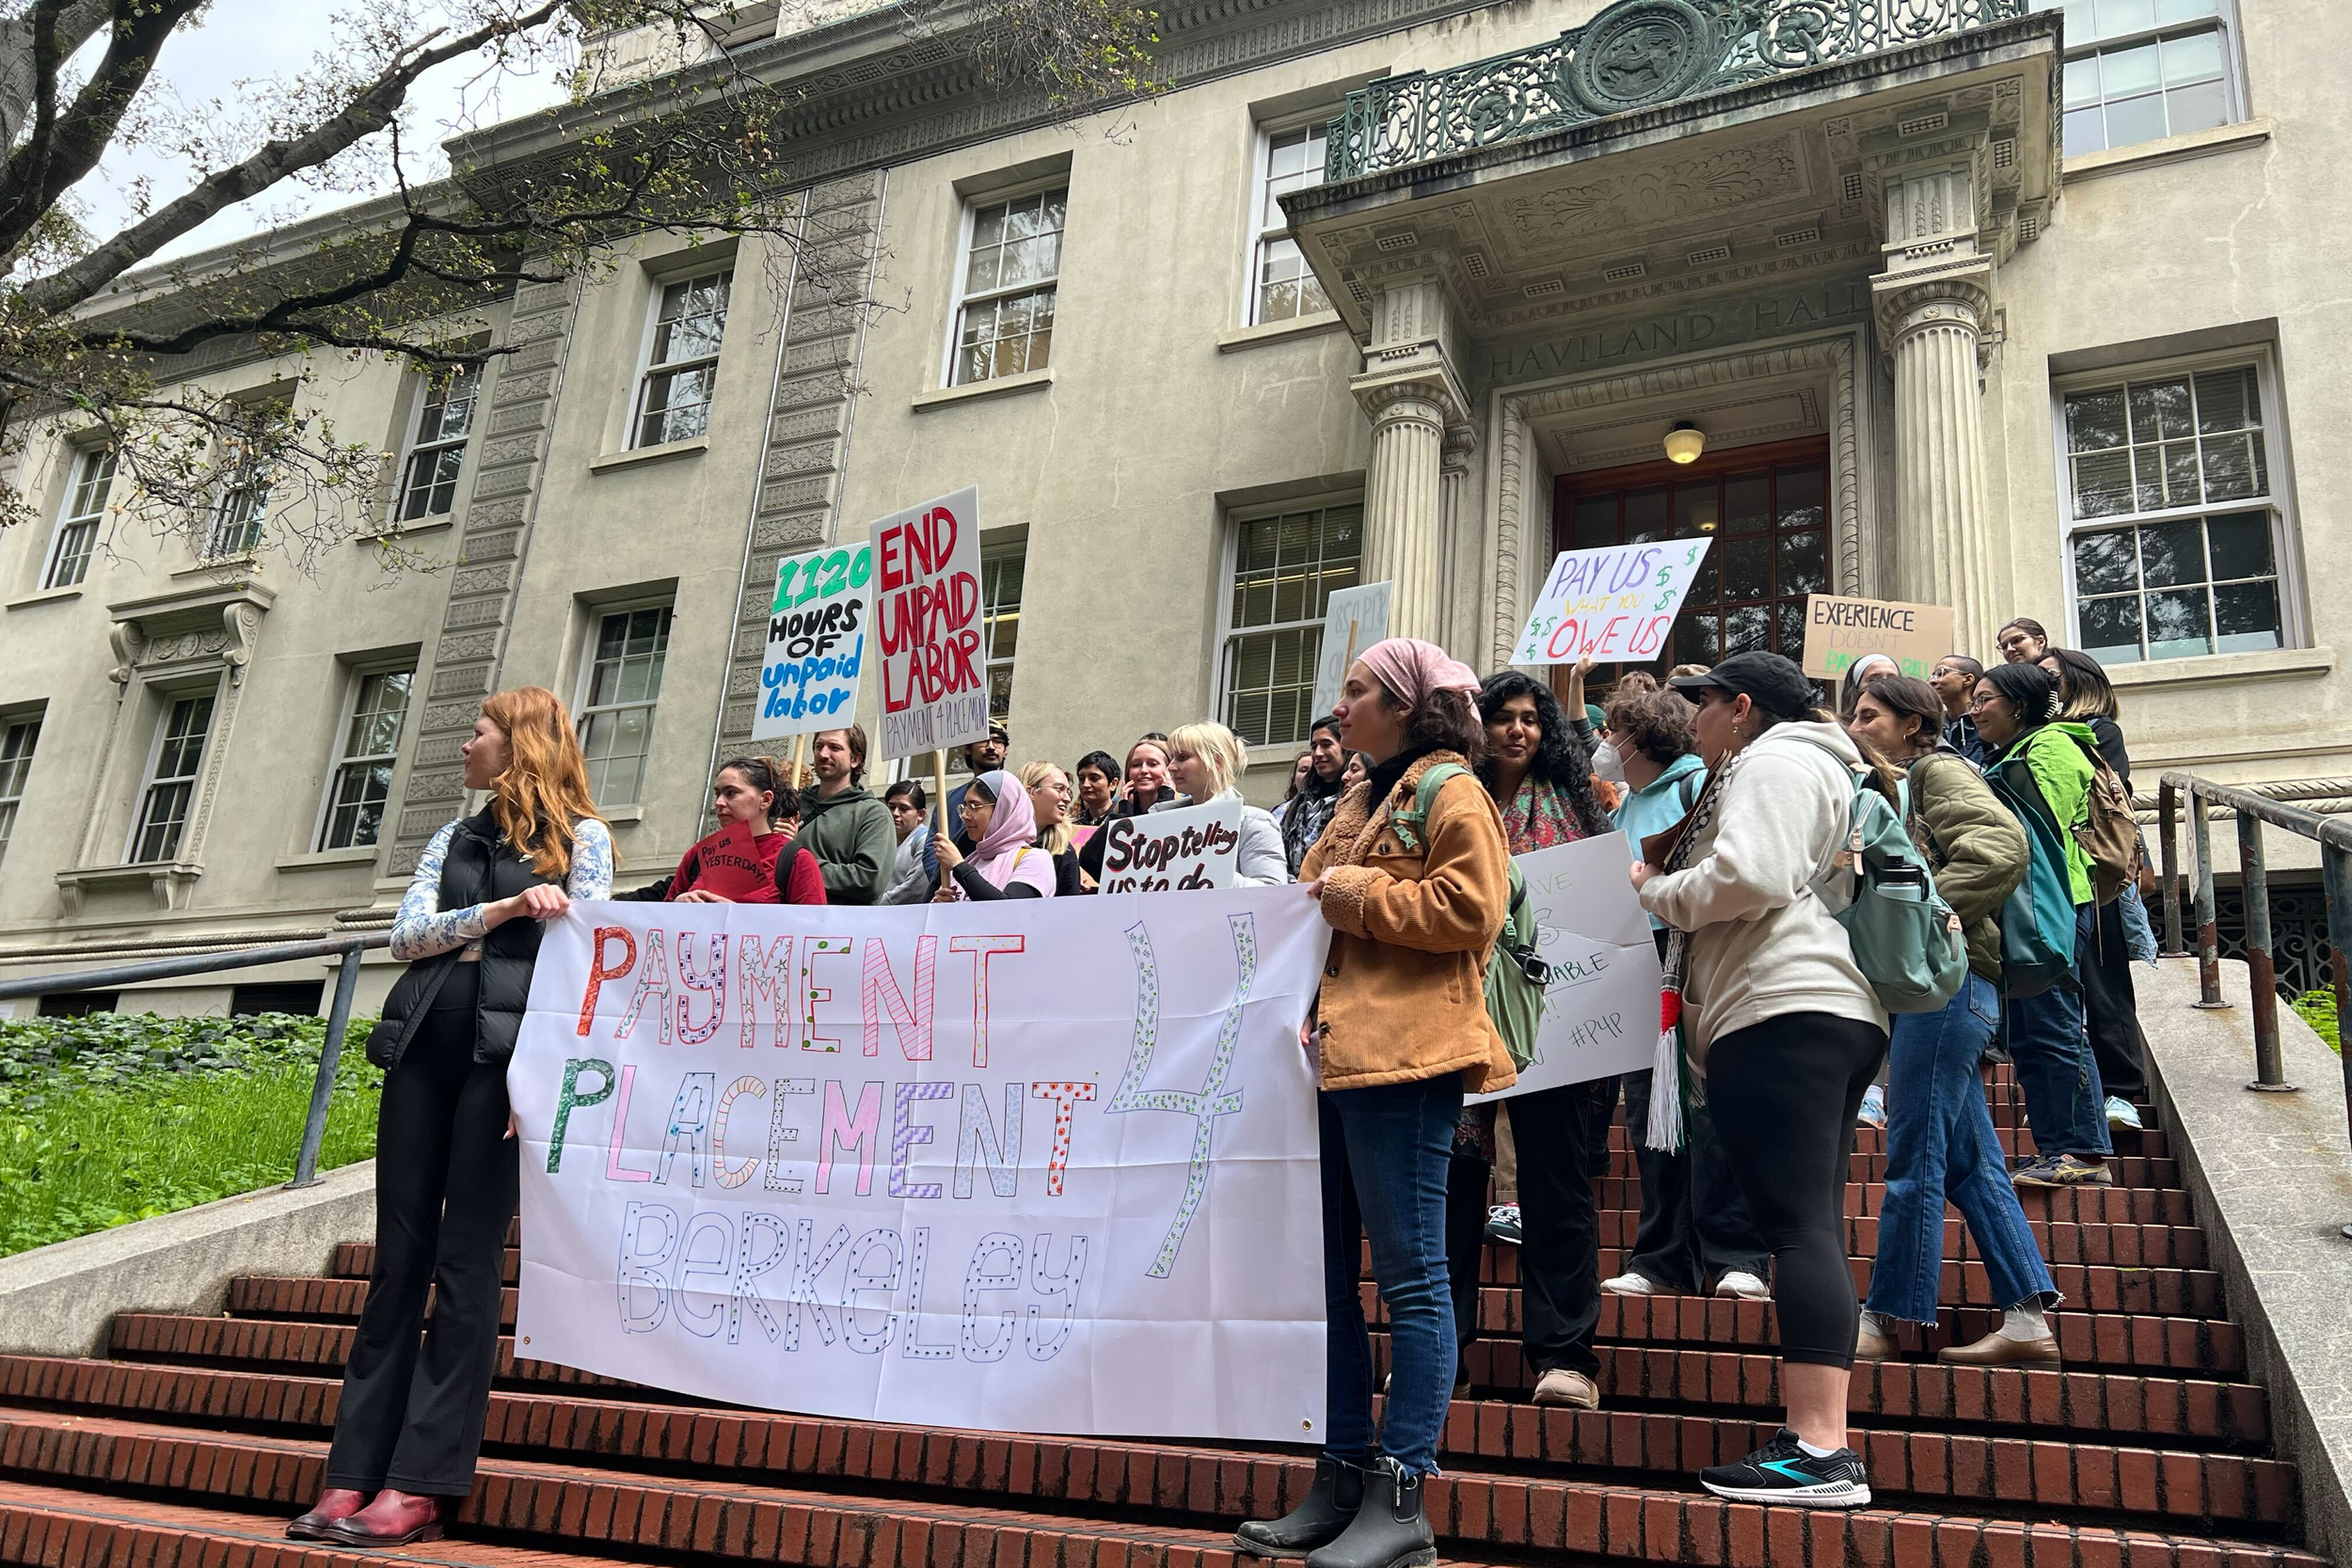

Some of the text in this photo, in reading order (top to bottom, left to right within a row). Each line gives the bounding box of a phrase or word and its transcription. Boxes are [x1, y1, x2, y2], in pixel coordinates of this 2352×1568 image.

[1489, 282, 1873, 379] HAVILAND HALL
[880, 506, 958, 593] END
[1550, 547, 1662, 599] PAY US
[771, 546, 871, 615] 1120
[1565, 594, 1645, 616] WHAT YOU
[768, 598, 864, 642] HOURS
[878, 571, 978, 657] UNPAID
[1547, 615, 1671, 658] OWE US
[1814, 600, 1915, 632] EXPERIENCE
[1830, 628, 1902, 651] DOESN'T
[762, 633, 864, 689] unpaid
[787, 634, 842, 659] OF
[882, 629, 982, 715] LABOR
[763, 687, 851, 721] labor
[885, 705, 934, 755] PAYMENT
[937, 704, 945, 740] 4
[702, 836, 732, 858] Pay us
[705, 854, 767, 884] YESTERDAY!
[1105, 818, 1180, 873] Stop
[1180, 820, 1239, 860] telling
[575, 925, 1026, 1069] PAYMENT
[1567, 1012, 1624, 1049] #P4P
[1103, 911, 1256, 1279] 4
[546, 1056, 1099, 1199] PLACEMENT
